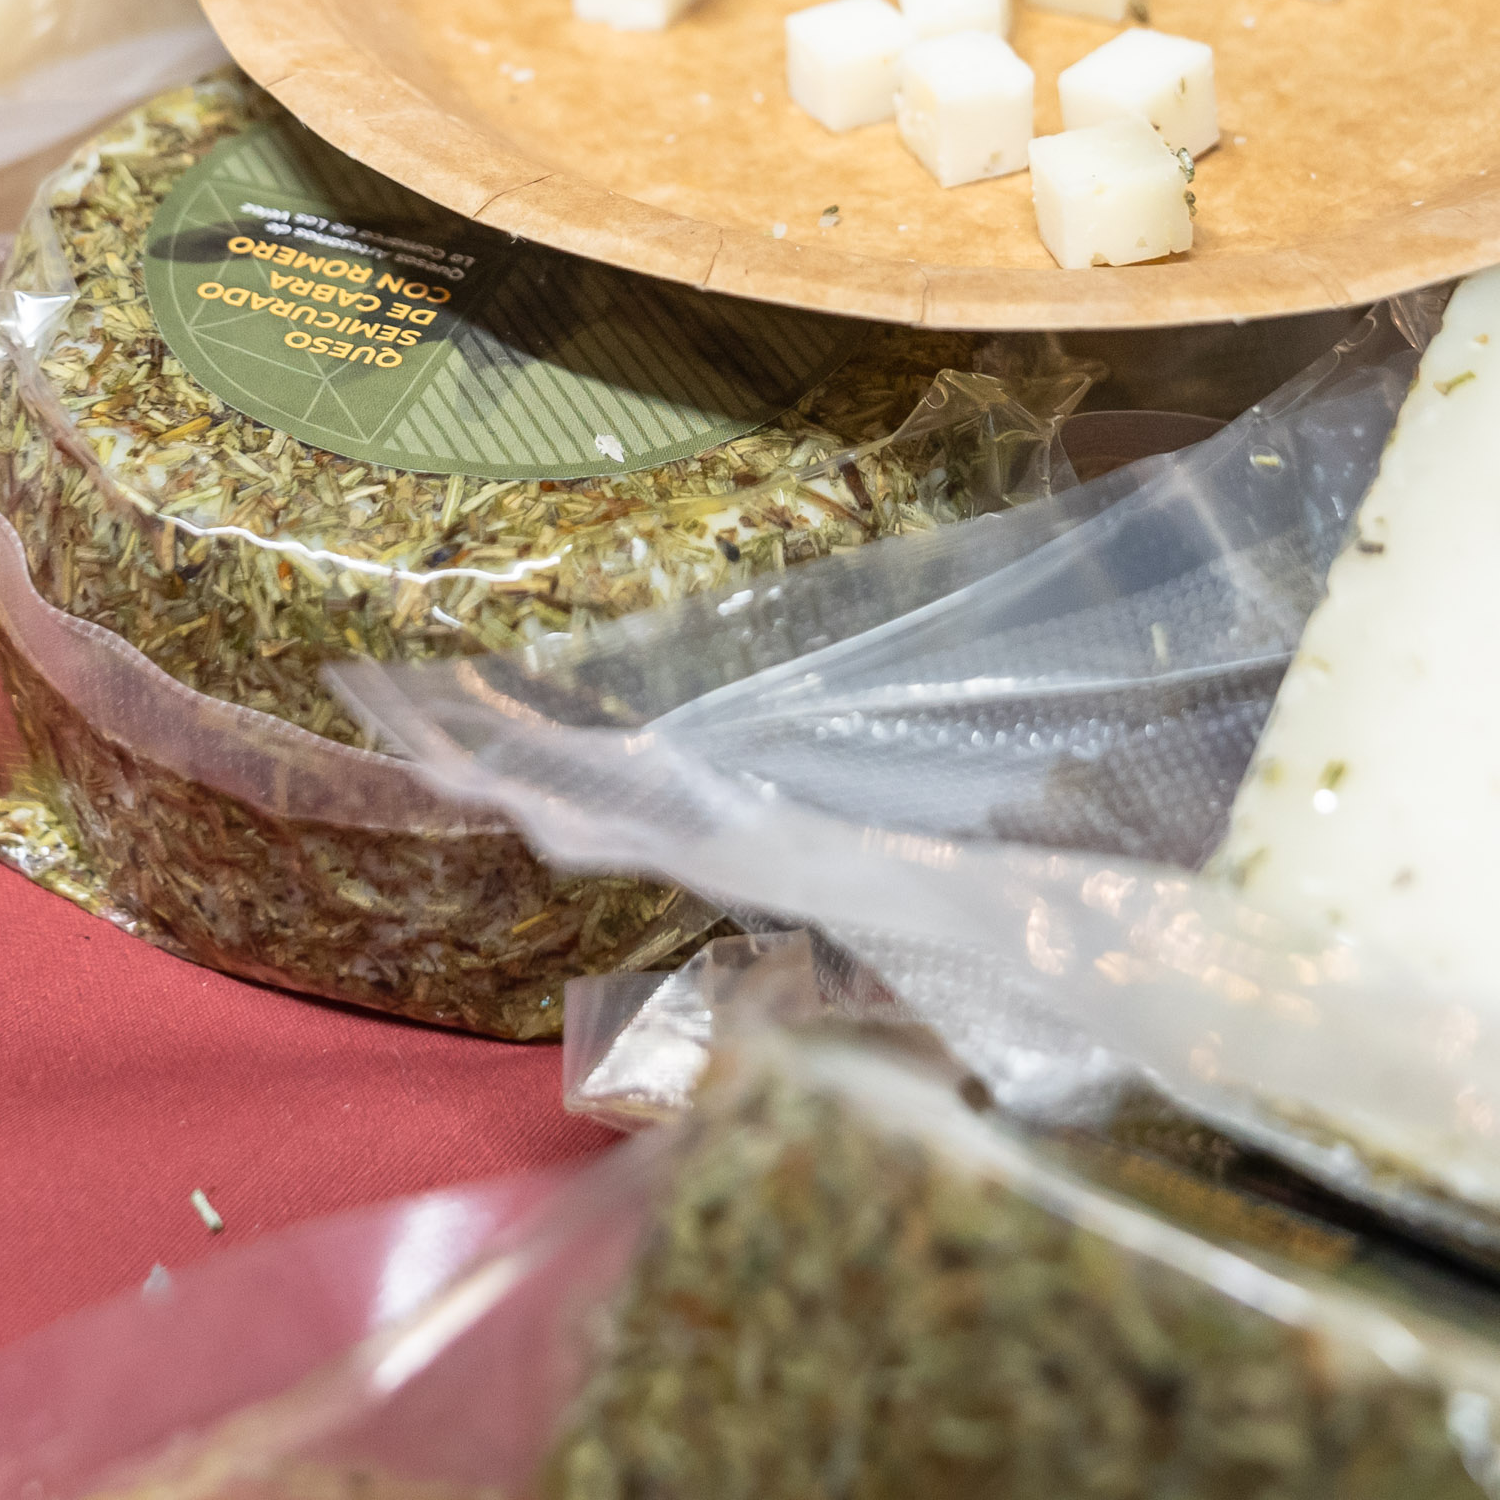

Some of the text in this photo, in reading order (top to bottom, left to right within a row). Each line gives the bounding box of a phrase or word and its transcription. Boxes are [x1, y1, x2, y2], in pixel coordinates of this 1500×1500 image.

[293, 227, 390, 260] Artesanos
[227, 236, 451, 303] CON ROMERO
[394, 253, 465, 281] Quesos
[197, 282, 422, 346] SEMICURADO
[270, 270, 438, 325] DE CABRA
[284, 331, 403, 368] QUESO
